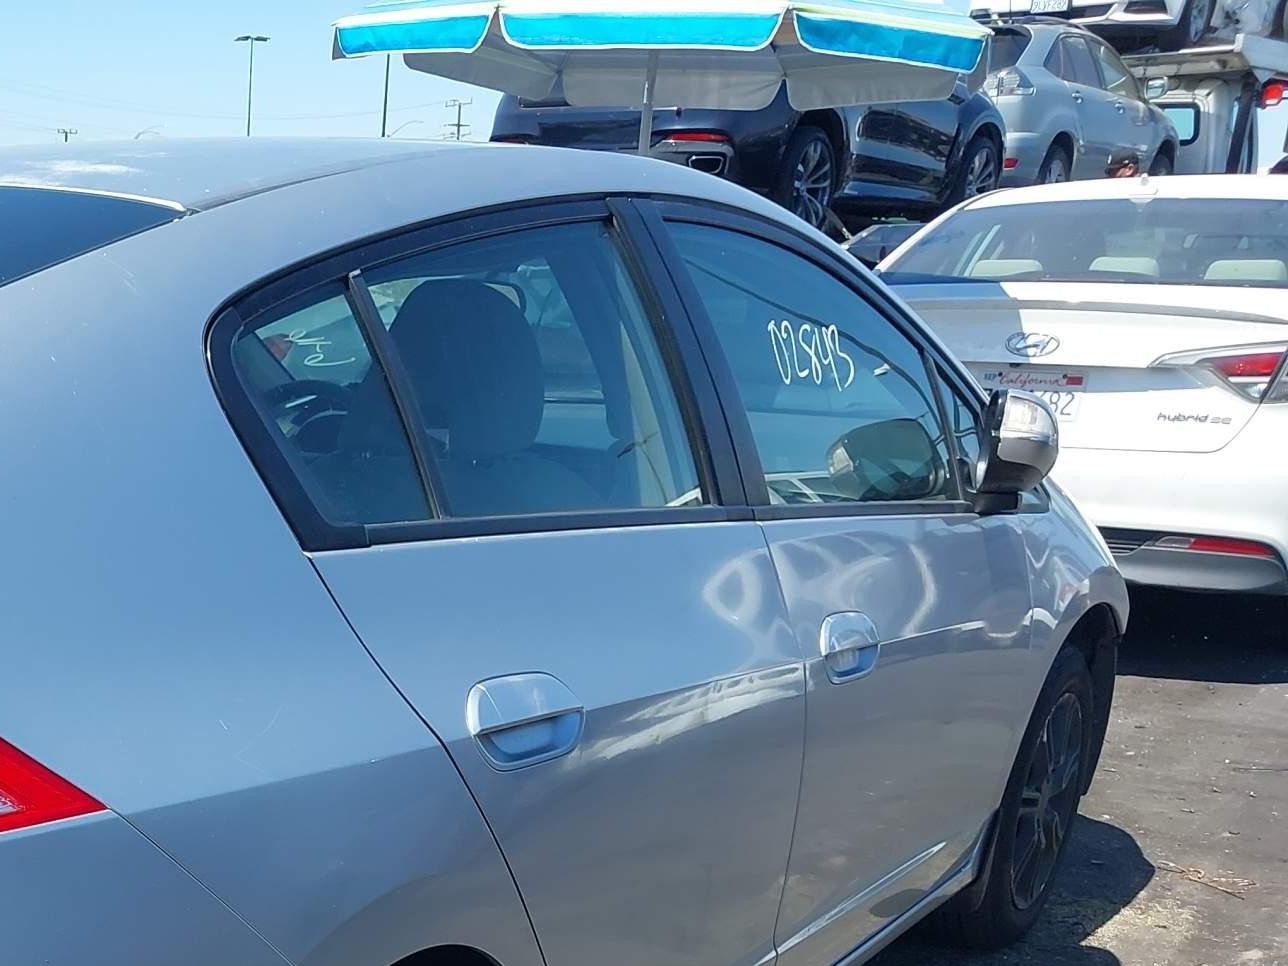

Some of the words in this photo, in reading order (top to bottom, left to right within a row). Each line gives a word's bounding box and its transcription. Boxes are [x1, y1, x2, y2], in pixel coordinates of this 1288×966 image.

[768, 320, 855, 392] 02843
[999, 373, 1064, 388] California
[1157, 412, 1209, 424] hybrid
